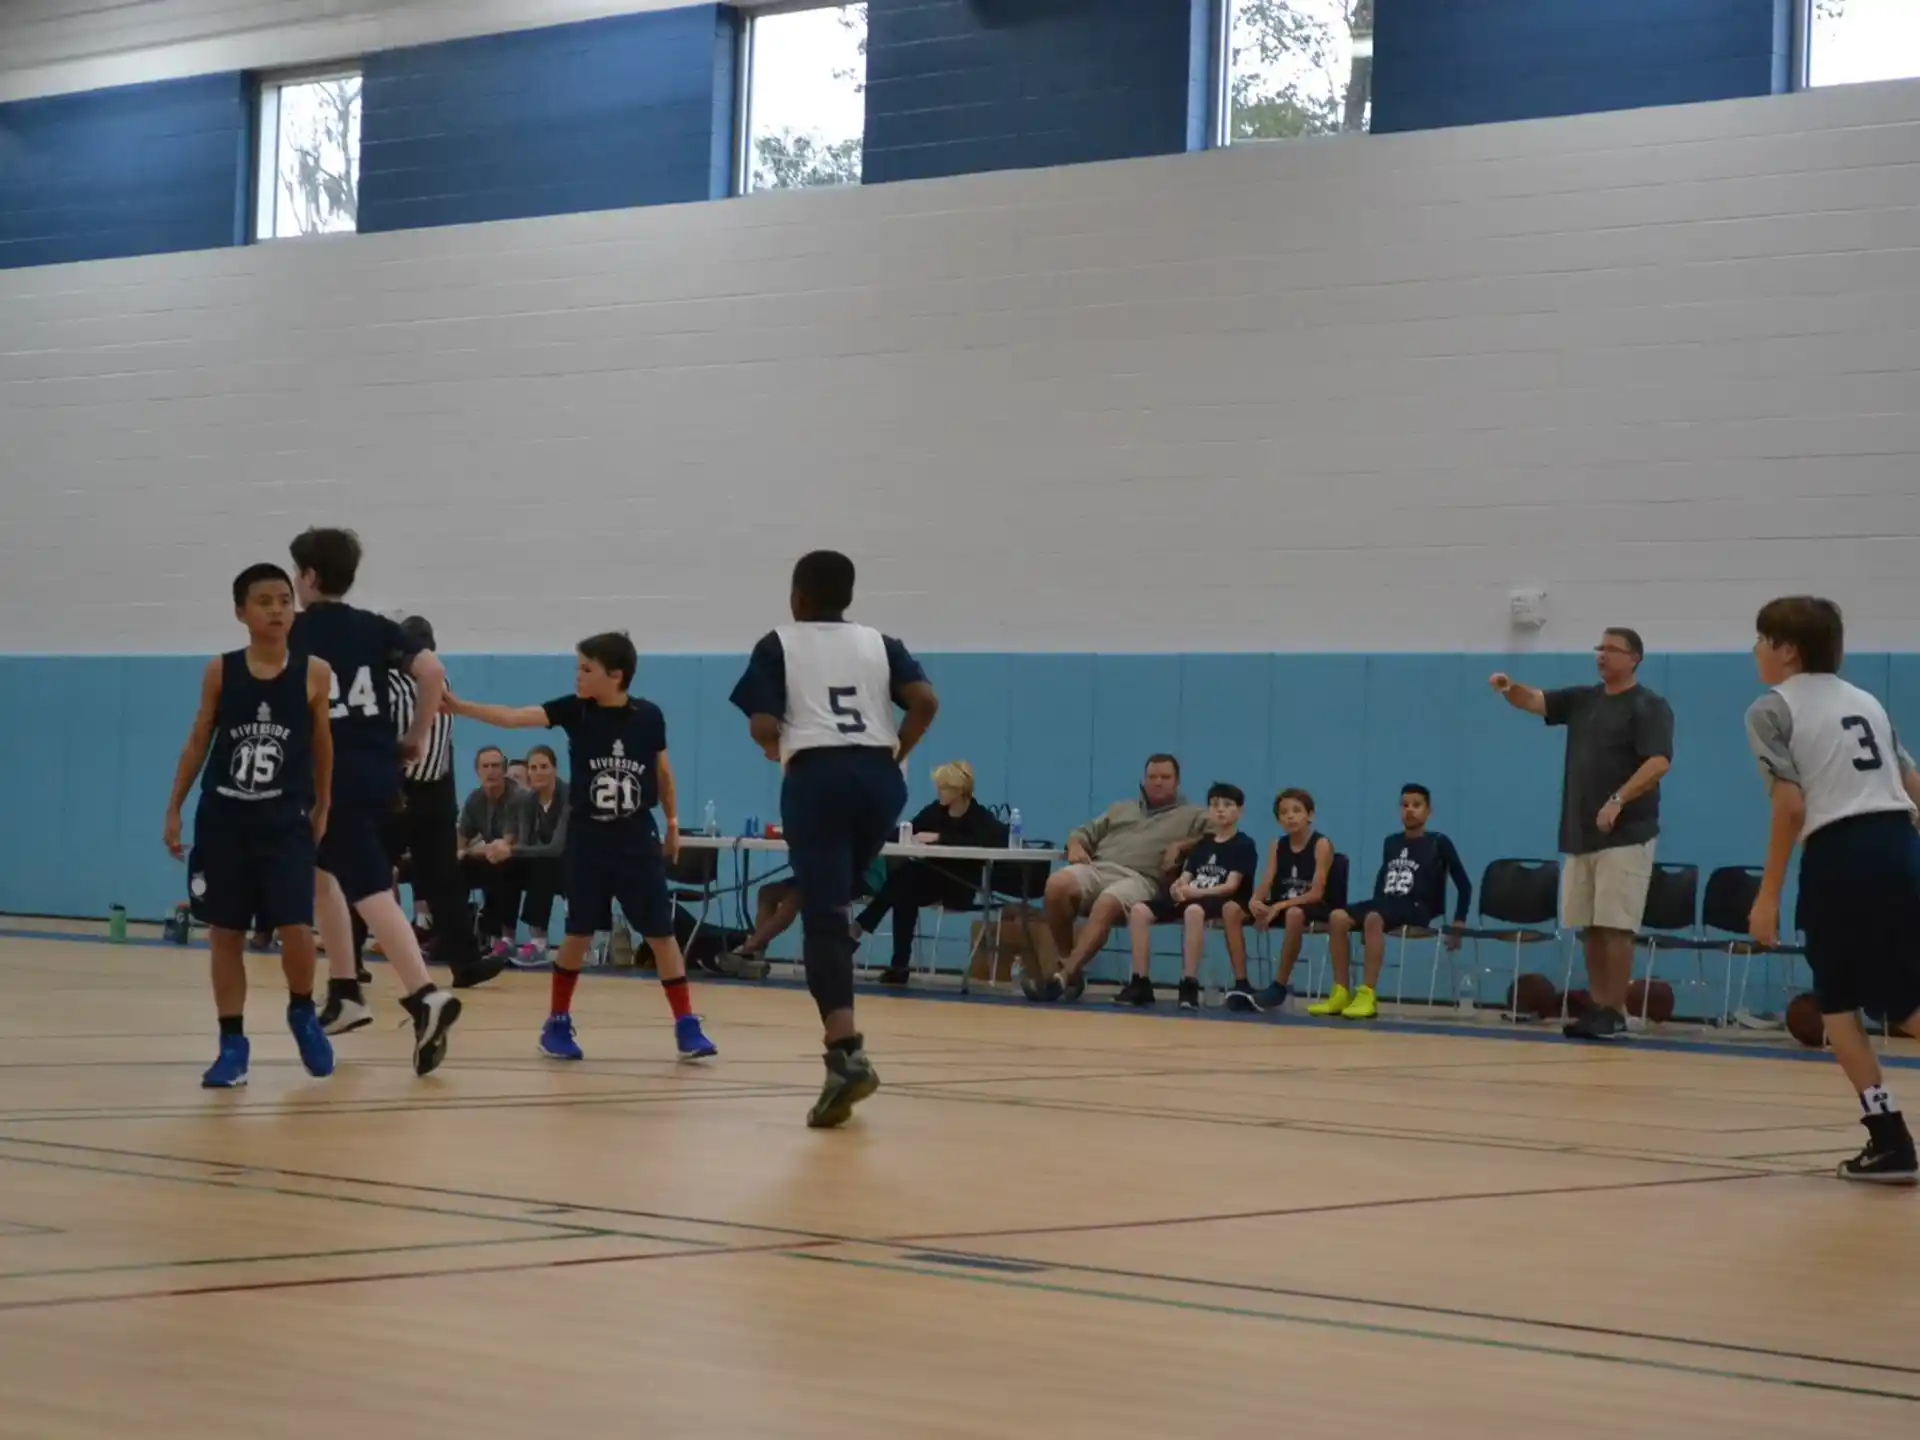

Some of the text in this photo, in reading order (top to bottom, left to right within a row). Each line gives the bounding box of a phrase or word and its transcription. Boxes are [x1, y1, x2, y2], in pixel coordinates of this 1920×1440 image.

[828, 685, 867, 735] 5
[236, 744, 278, 783] 15
[1841, 714, 1883, 772] 3
[596, 775, 634, 810] 21
